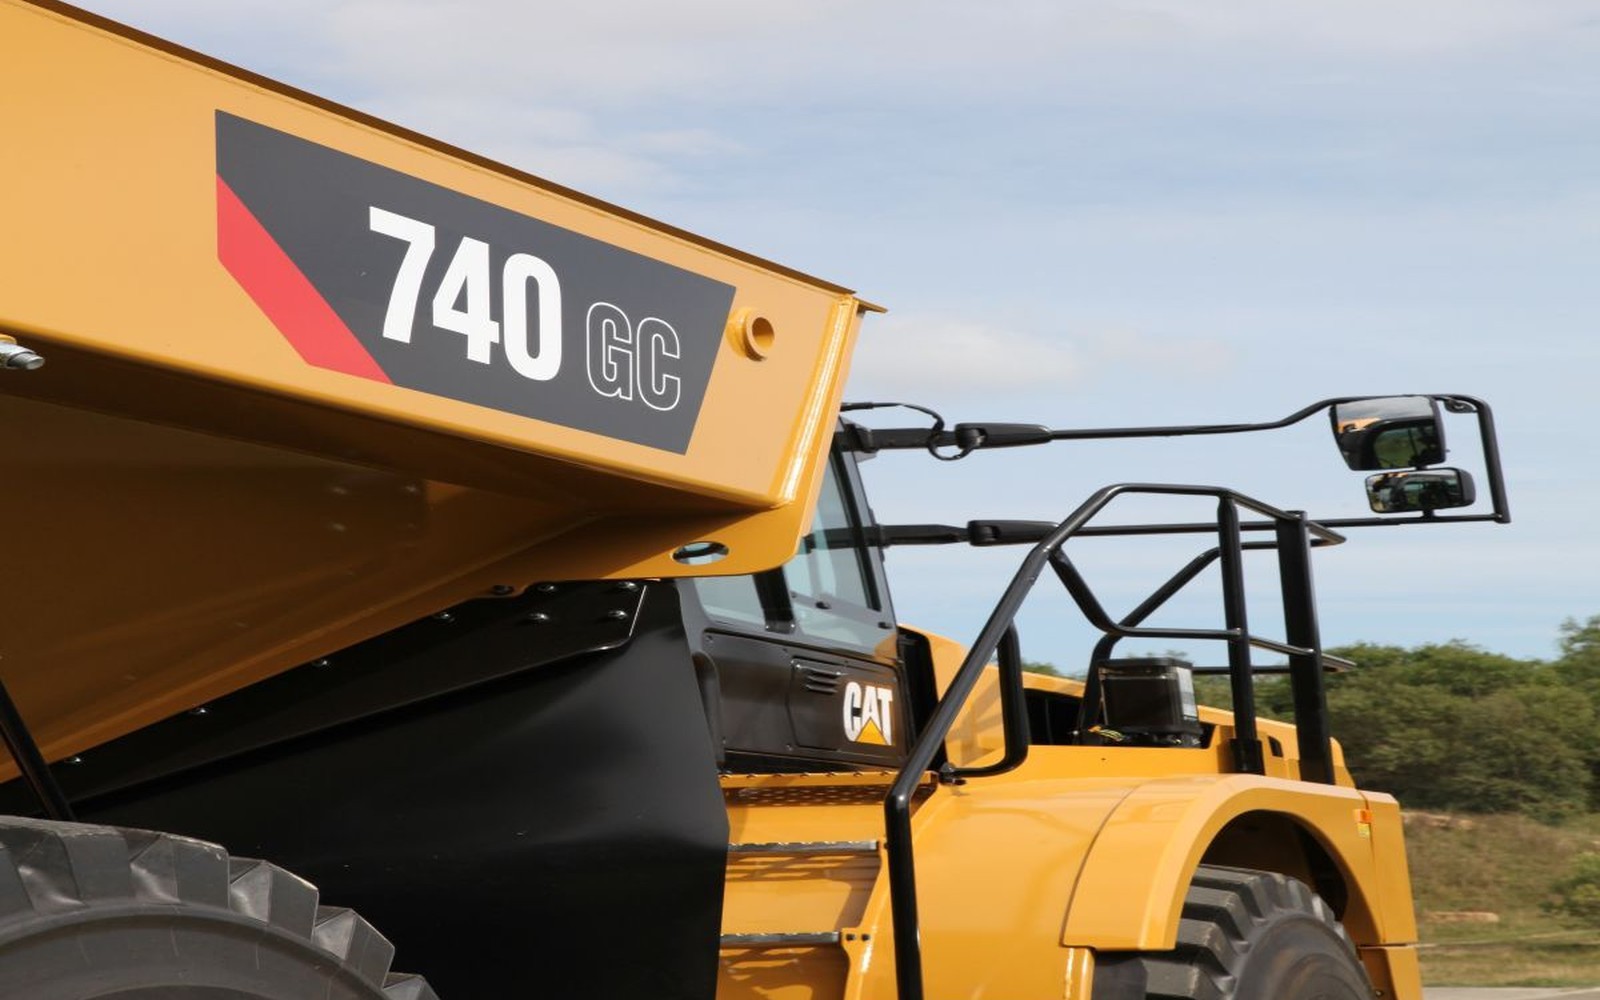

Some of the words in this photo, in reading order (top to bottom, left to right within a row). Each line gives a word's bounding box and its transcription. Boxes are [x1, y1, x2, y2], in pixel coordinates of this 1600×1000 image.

[369, 206, 562, 381] 740
[586, 301, 681, 411] GC
[843, 681, 893, 746] CAT
